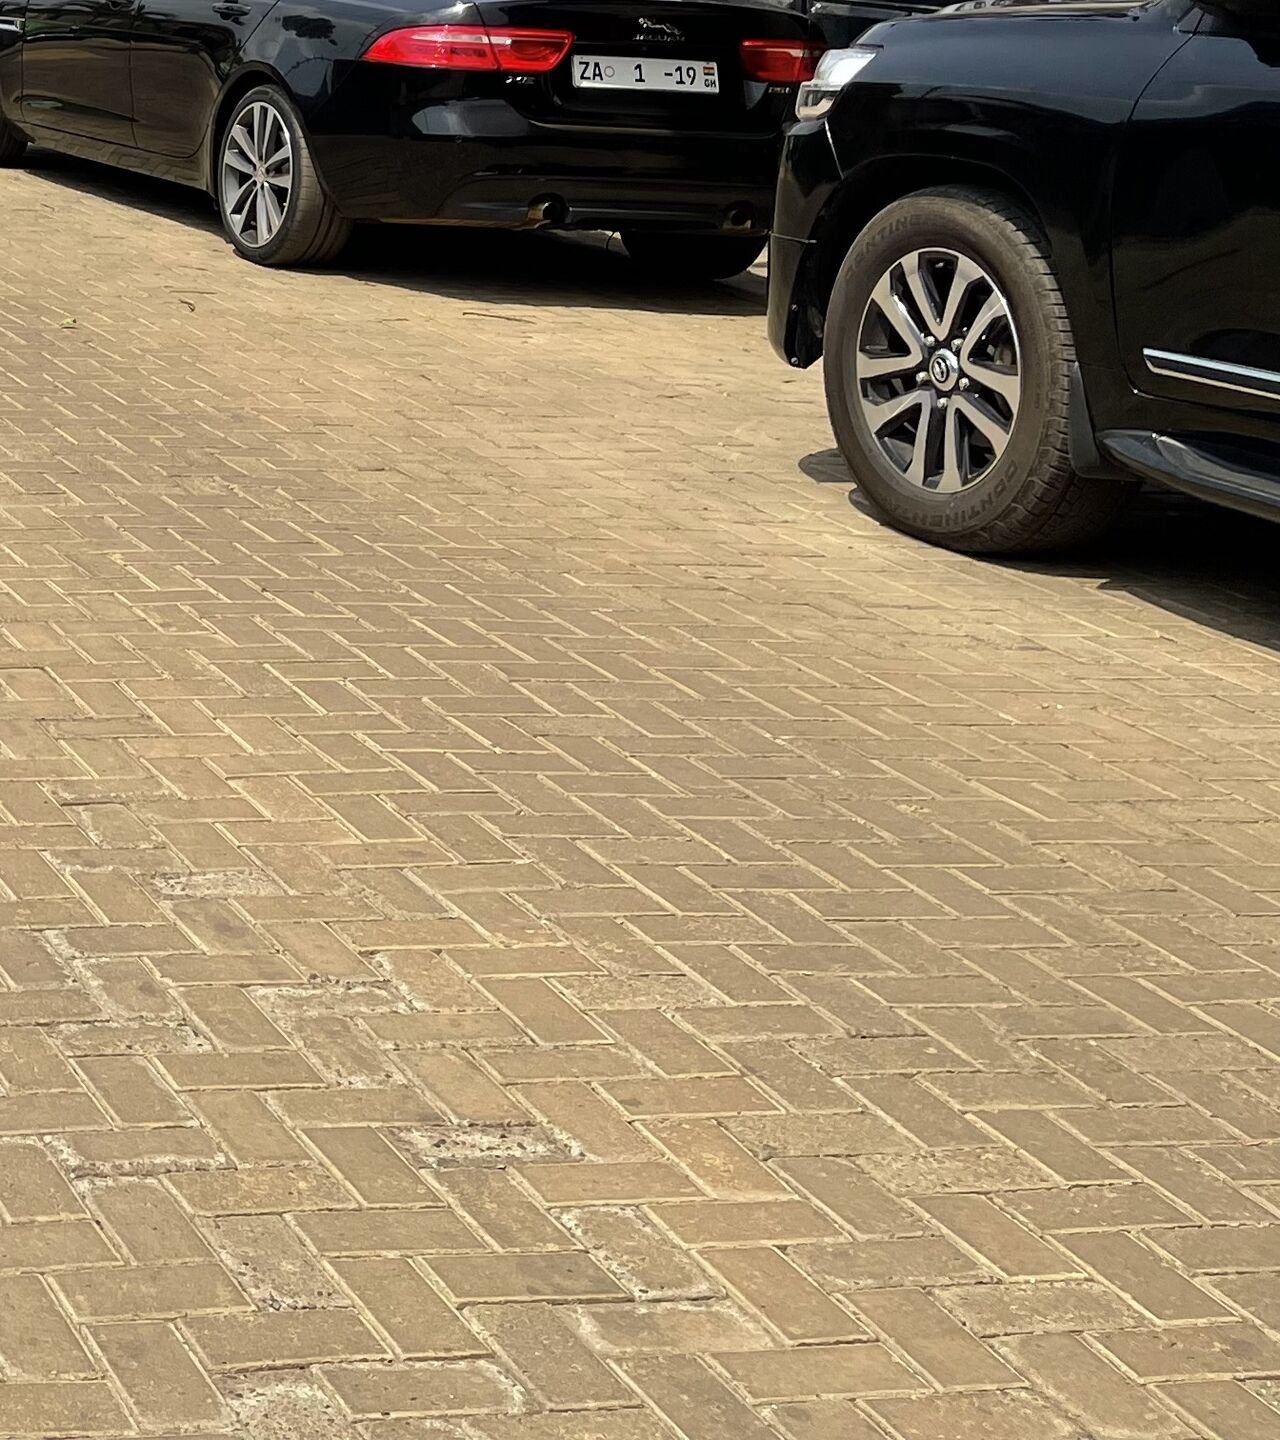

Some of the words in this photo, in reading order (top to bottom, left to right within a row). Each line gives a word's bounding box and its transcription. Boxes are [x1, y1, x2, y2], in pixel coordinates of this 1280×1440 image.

[579, 61, 603, 81] ZA
[634, 63, 645, 83] 1
[664, 66, 696, 86] -19
[704, 79, 717, 88] GH
